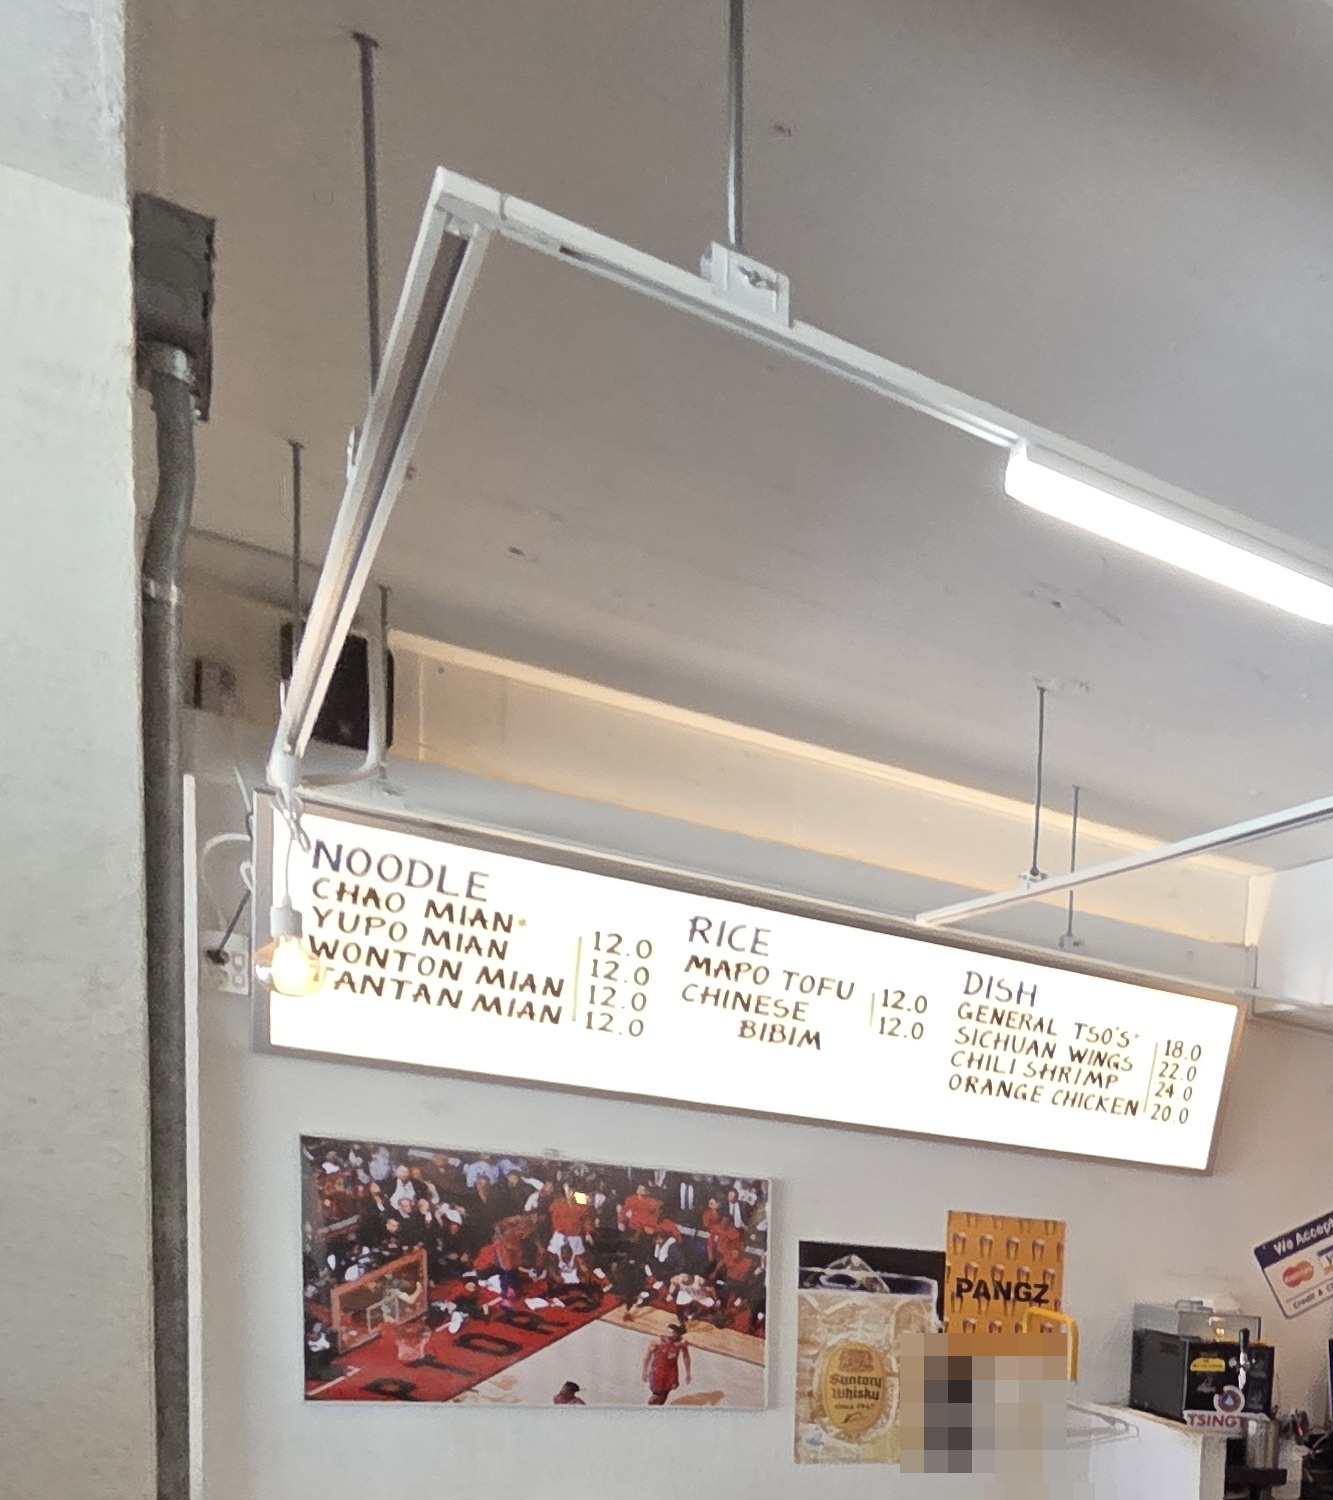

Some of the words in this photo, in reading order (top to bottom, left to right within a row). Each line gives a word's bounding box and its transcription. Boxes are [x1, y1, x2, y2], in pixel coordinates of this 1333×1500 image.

[312, 839, 489, 901] NOODLE
[312, 877, 406, 913] CHAO
[424, 899, 513, 933] MIAN
[593, 931, 653, 959] 12.0
[688, 915, 772, 957] RICE
[312, 905, 408, 942] YUPO
[421, 927, 508, 960] MIAN
[590, 958, 650, 986] 12.0
[309, 934, 462, 981] WONTON
[475, 966, 564, 997] MIAN
[588, 985, 647, 1012] 12.0
[684, 955, 770, 985] MAPO
[783, 969, 855, 1000] TOFU
[882, 988, 928, 1014] 12.0
[962, 970, 1038, 1007] DISH
[471, 993, 562, 1024] MIAN
[585, 1012, 644, 1037] 12.0
[681, 983, 809, 1022] CHINESE
[878, 1016, 924, 1040] 12.0
[737, 1019, 822, 1051] BIBIM
[957, 1001, 1058, 1037] GENERAL
[1164, 1039, 1202, 1062] 18.0
[951, 1050, 1017, 1075] CHILI
[1023, 1061, 1119, 1090] SHRIMP
[1155, 1082, 1193, 1102] 24.0
[954, 1026, 1057, 1060] SICHUAN
[1068, 1044, 1133, 1072] WINGS
[1158, 1061, 1197, 1082] 22.0
[948, 1074, 1045, 1104] ORANGE
[1051, 1089, 1139, 1117] CHICKEN
[1150, 1103, 1189, 1124] 20.0
[1274, 1239, 1293, 1256] We
[955, 1277, 1050, 1304] PANGZ
[829, 1373, 883, 1389] Suntory
[831, 1386, 880, 1402] Whisky
